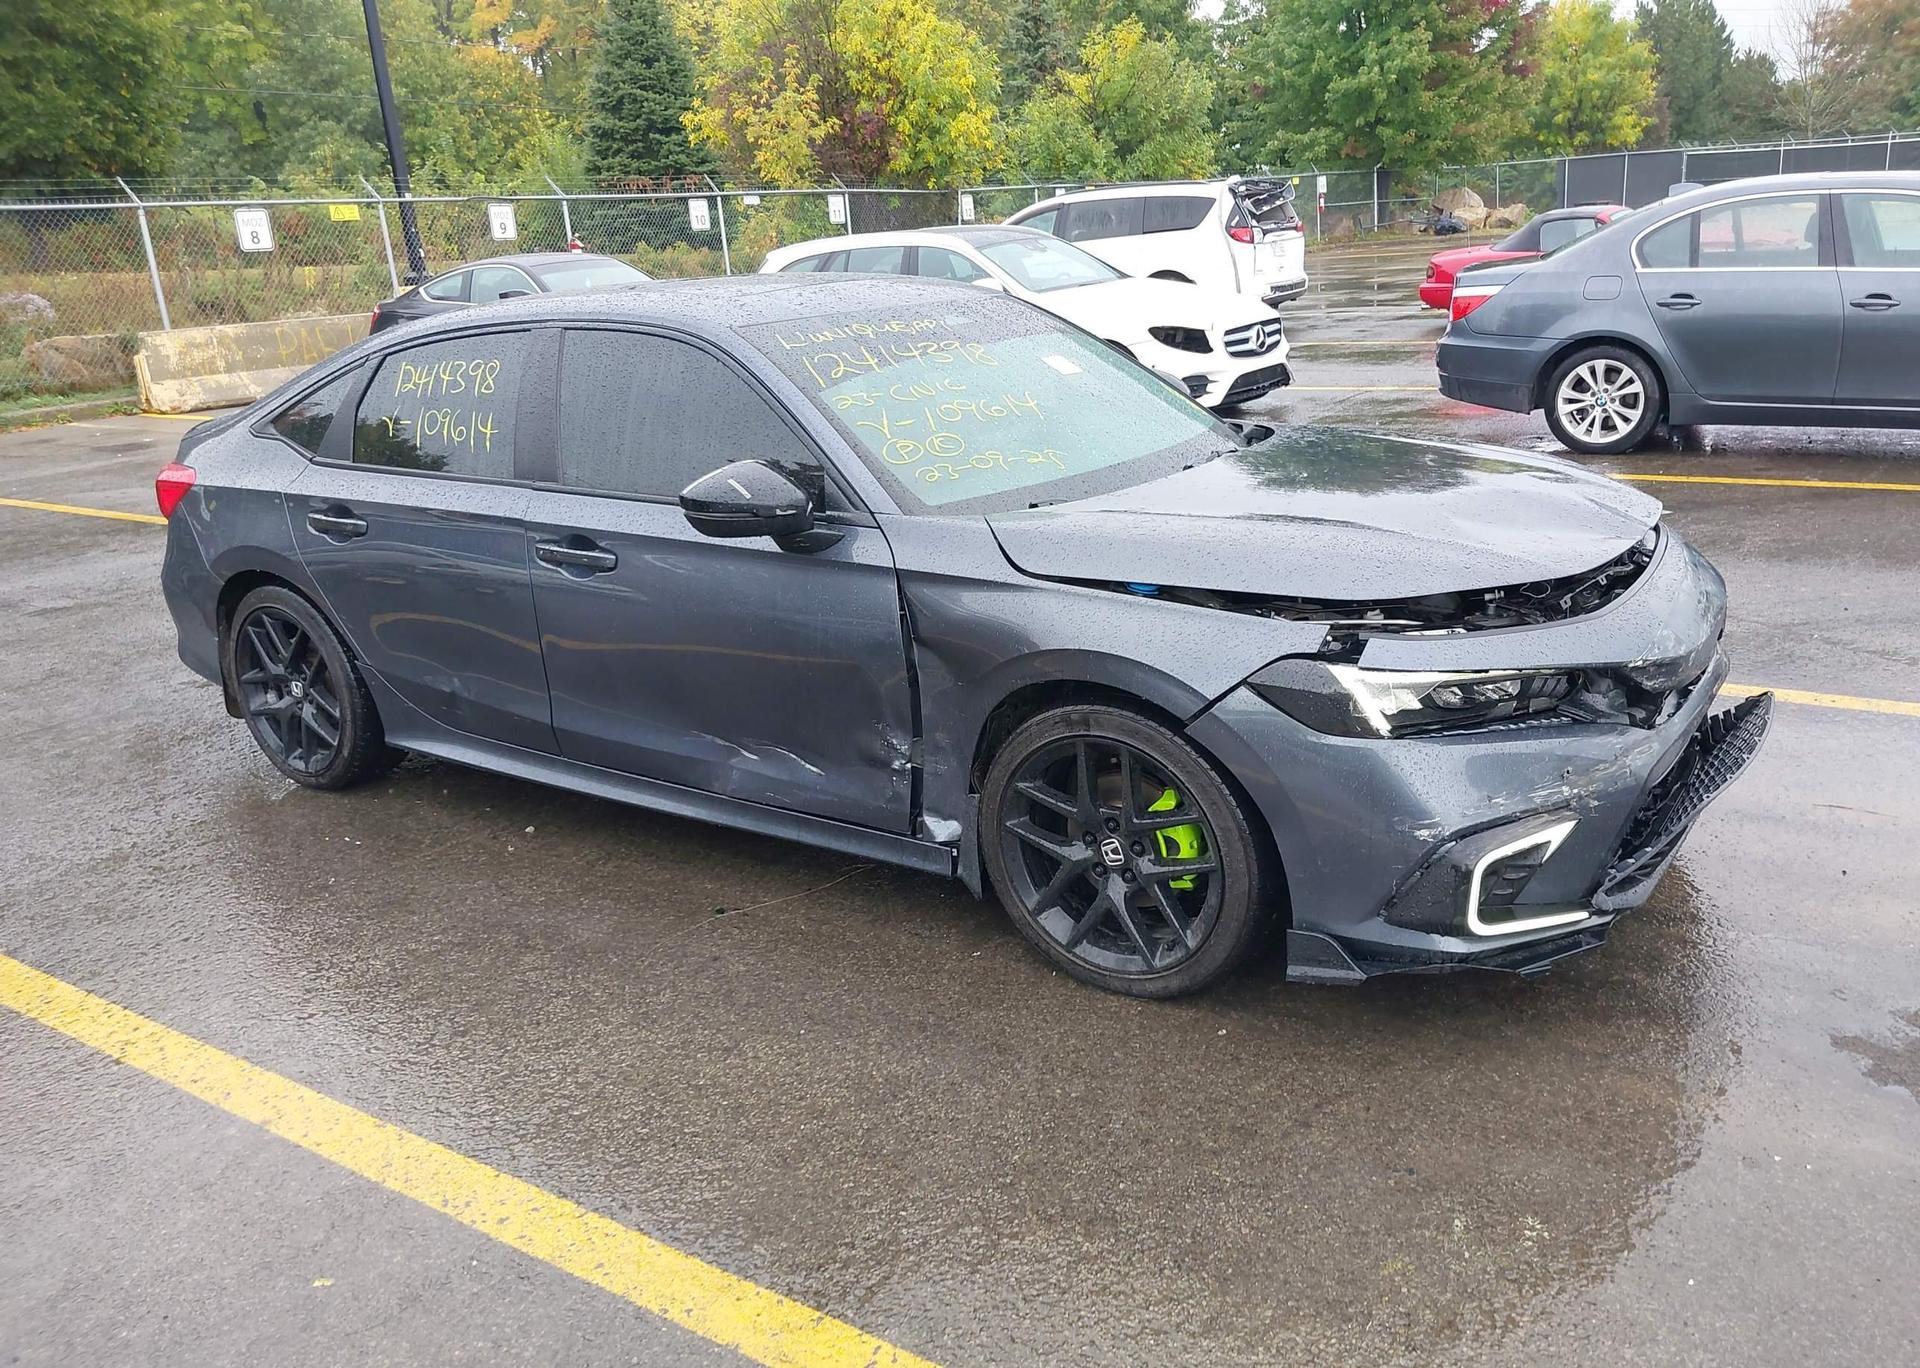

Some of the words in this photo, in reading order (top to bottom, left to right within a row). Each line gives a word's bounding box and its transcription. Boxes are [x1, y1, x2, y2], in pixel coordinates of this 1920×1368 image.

[832, 208, 842, 220] 11
[964, 207, 973, 218] 12
[694, 214, 707, 226] 10
[499, 222, 507, 235] 9
[250, 230, 261, 245] 8
[802, 340, 999, 389] 12414398
[394, 359, 501, 399] 12414398
